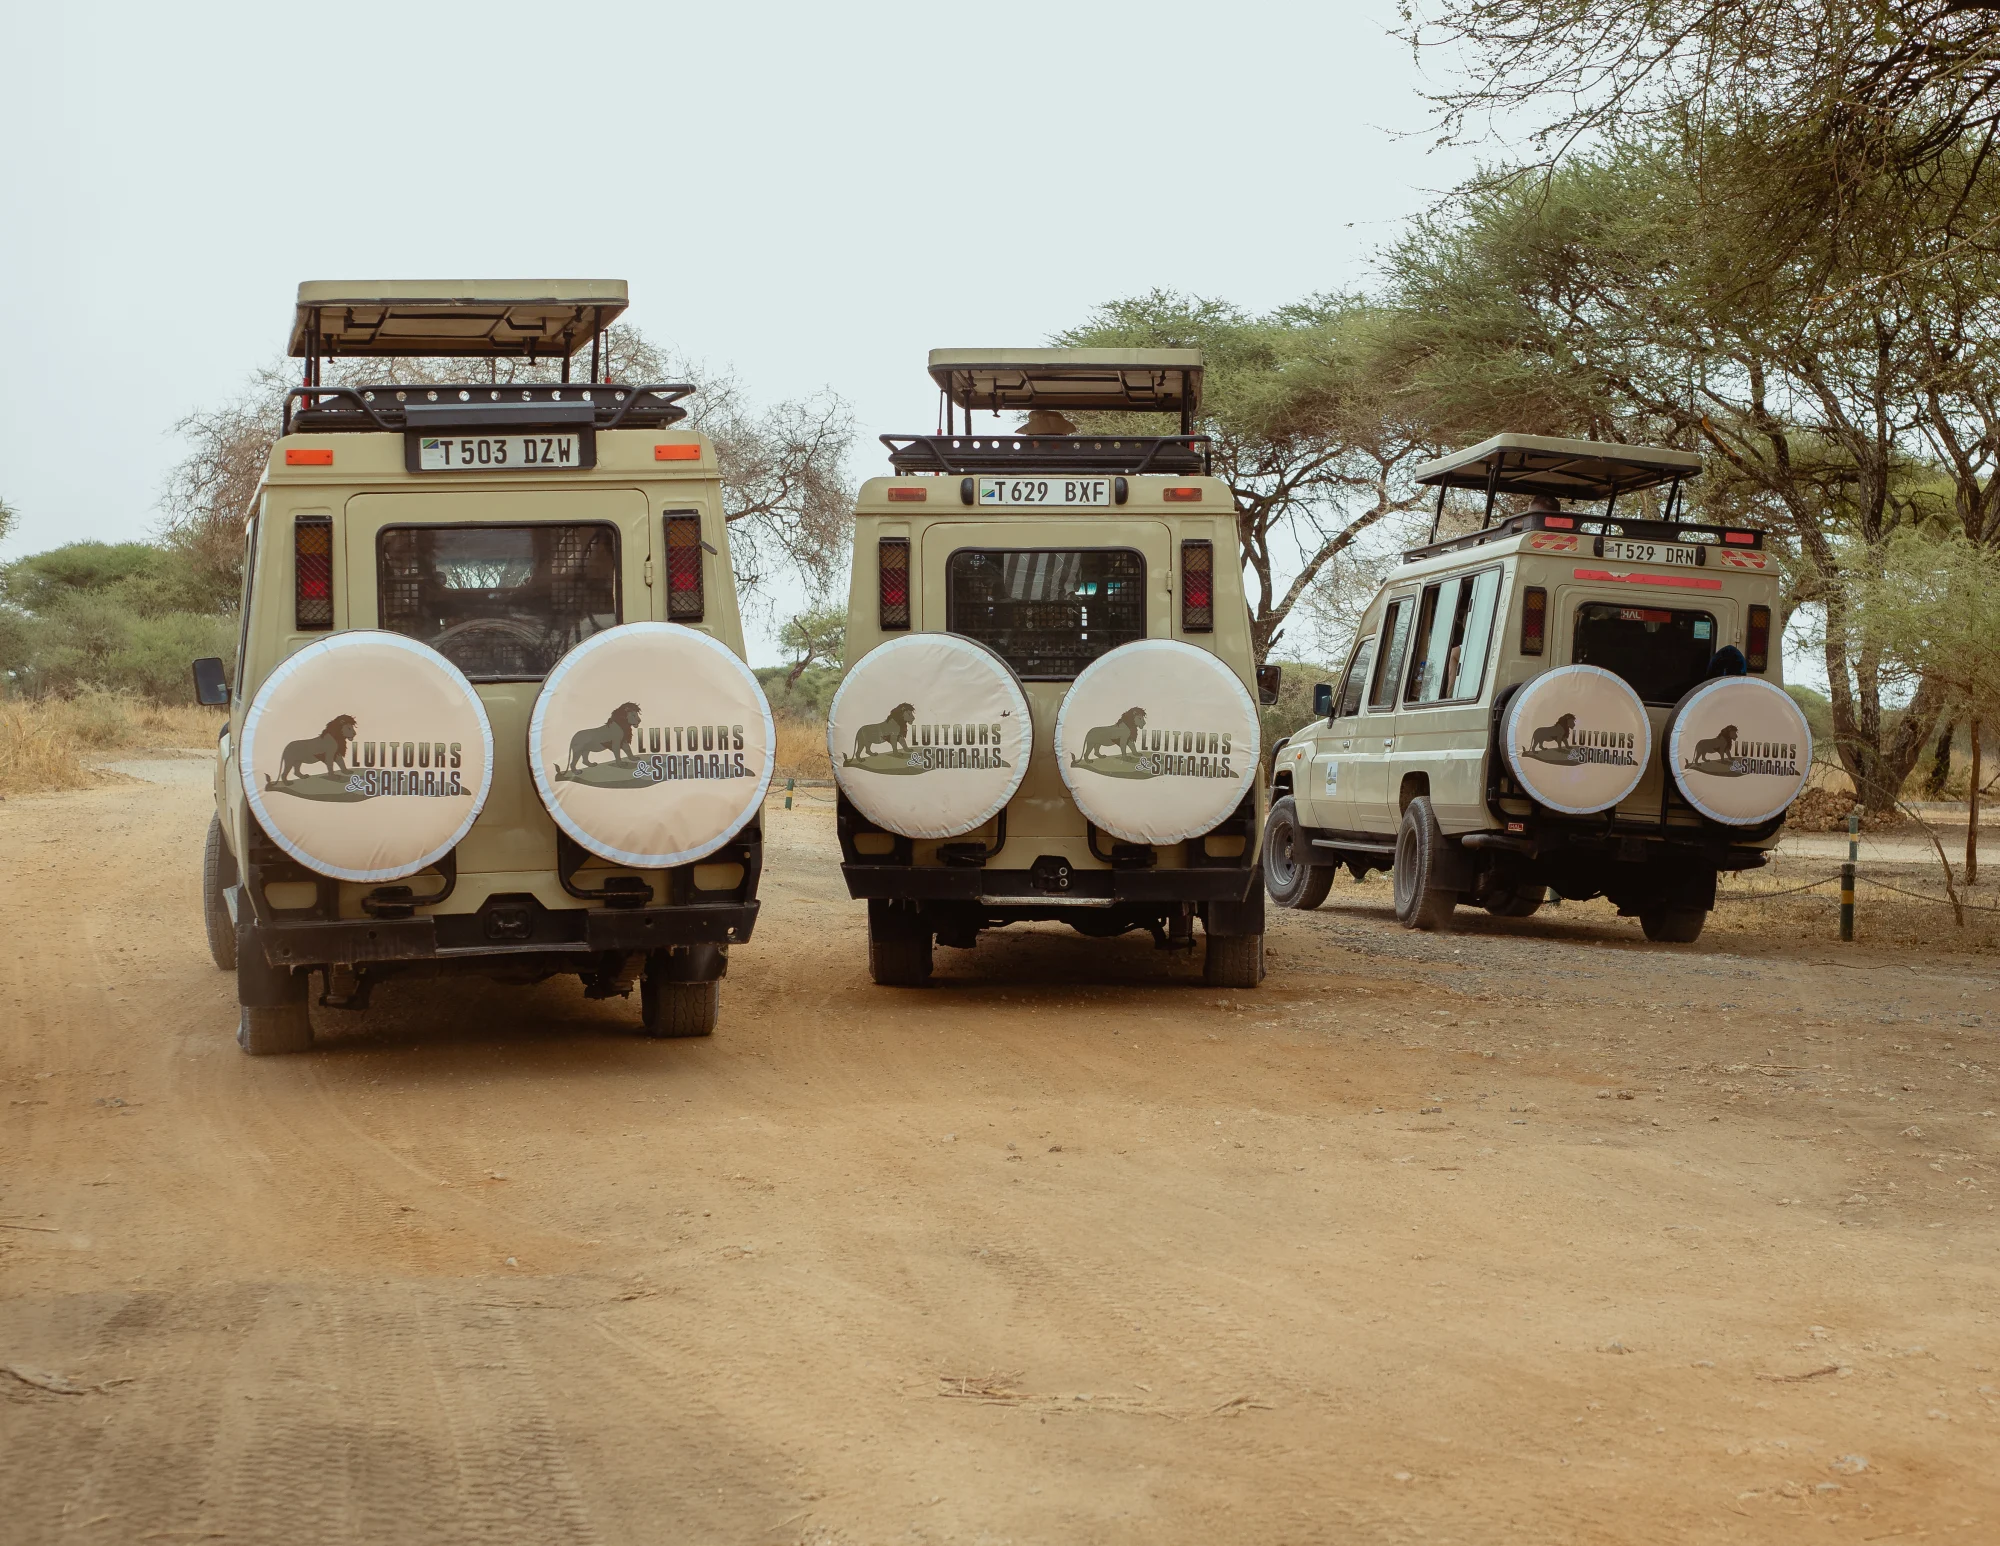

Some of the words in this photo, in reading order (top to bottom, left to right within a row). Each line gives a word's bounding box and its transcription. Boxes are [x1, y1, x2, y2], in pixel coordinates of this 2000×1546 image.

[440, 440, 453, 465] T
[460, 439, 508, 465] 503
[523, 438, 571, 464] DZW
[994, 481, 1006, 502] T
[1011, 481, 1049, 502] 629
[1065, 481, 1105, 502] BXF
[1614, 543, 1623, 558] T
[1626, 544, 1655, 561] 529
[1665, 547, 1694, 564] DRN
[637, 725, 744, 753] LUITOURS
[911, 723, 1002, 746] LUITOURS
[1141, 729, 1232, 755] LUITOURS
[1571, 729, 1635, 749] LUITOURS
[352, 741, 462, 768] LUITOURS
[907, 751, 922, 766] &
[922, 747, 1002, 769] SAFARIS
[1578, 747, 1633, 766] SAFARIS
[1734, 740, 1797, 759] LUITOURS
[633, 760, 651, 779] &
[651, 752, 745, 781] SAFARIS
[1135, 757, 1151, 771] &
[1151, 753, 1231, 778] SAFARIS
[1741, 758, 1796, 776] SAFARIS
[345, 774, 364, 793] &
[364, 769, 461, 797] SAFARIS
